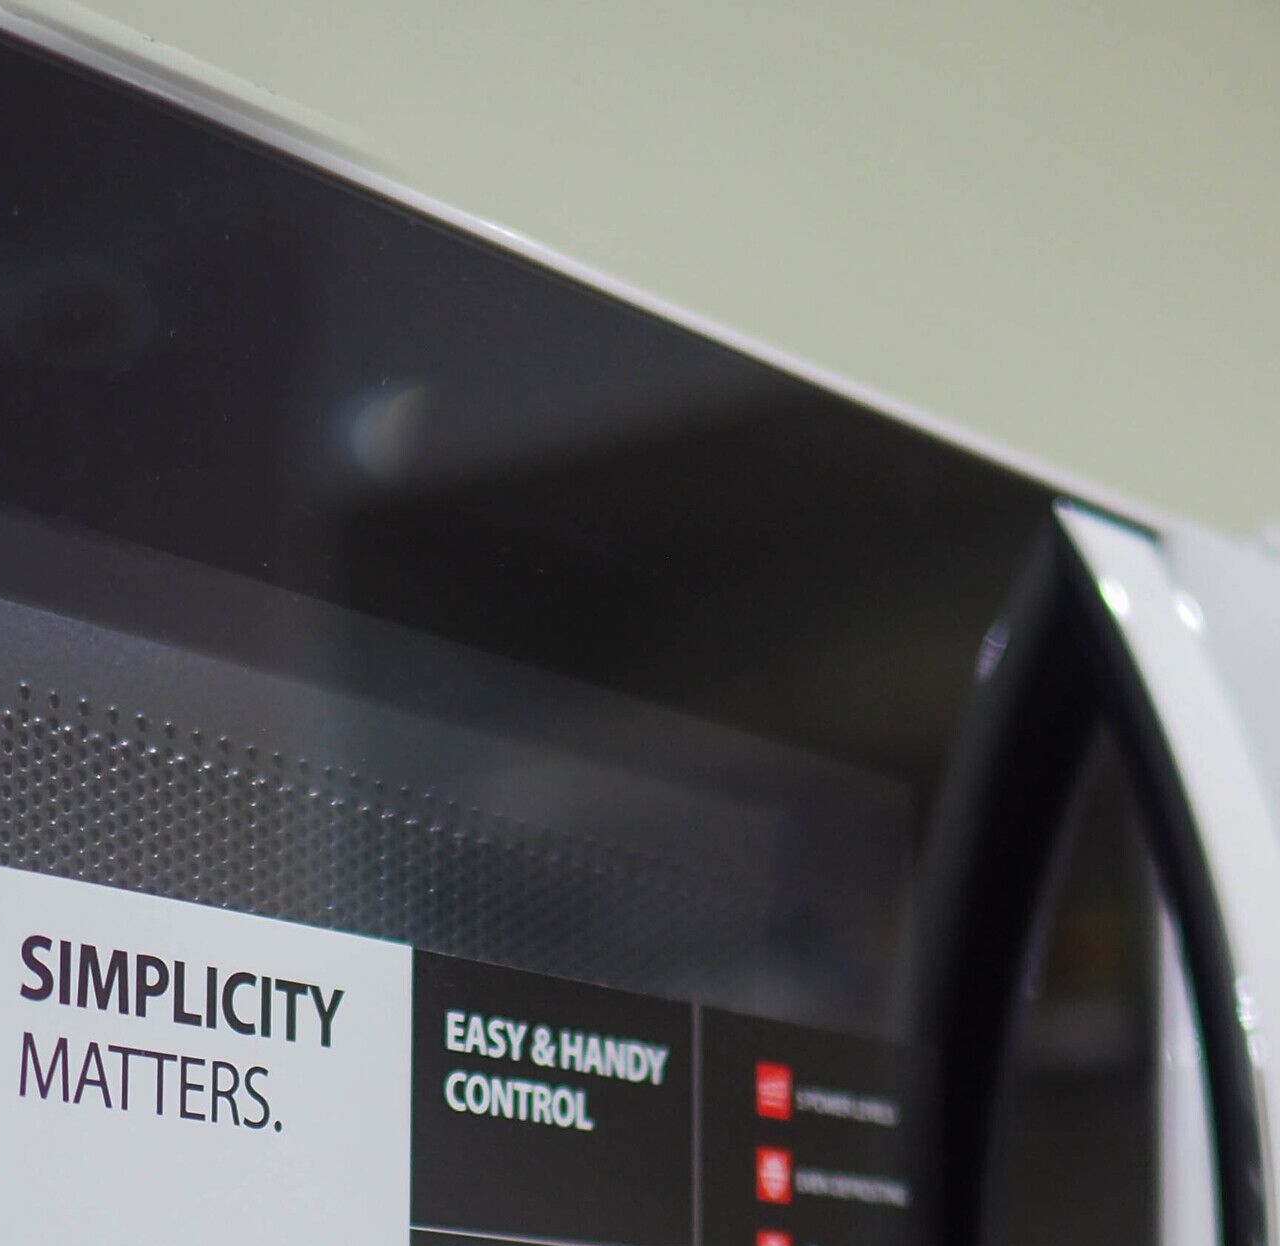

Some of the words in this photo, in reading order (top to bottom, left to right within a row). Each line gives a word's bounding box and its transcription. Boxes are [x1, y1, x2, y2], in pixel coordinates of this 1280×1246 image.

[19, 934, 345, 1048] SIMPLICITY
[19, 1031, 283, 1133] MATTERS.
[445, 1010, 527, 1062] EASY
[530, 1025, 556, 1068] &
[560, 1031, 668, 1086] HANDY
[444, 1070, 594, 1132] CONTROL
